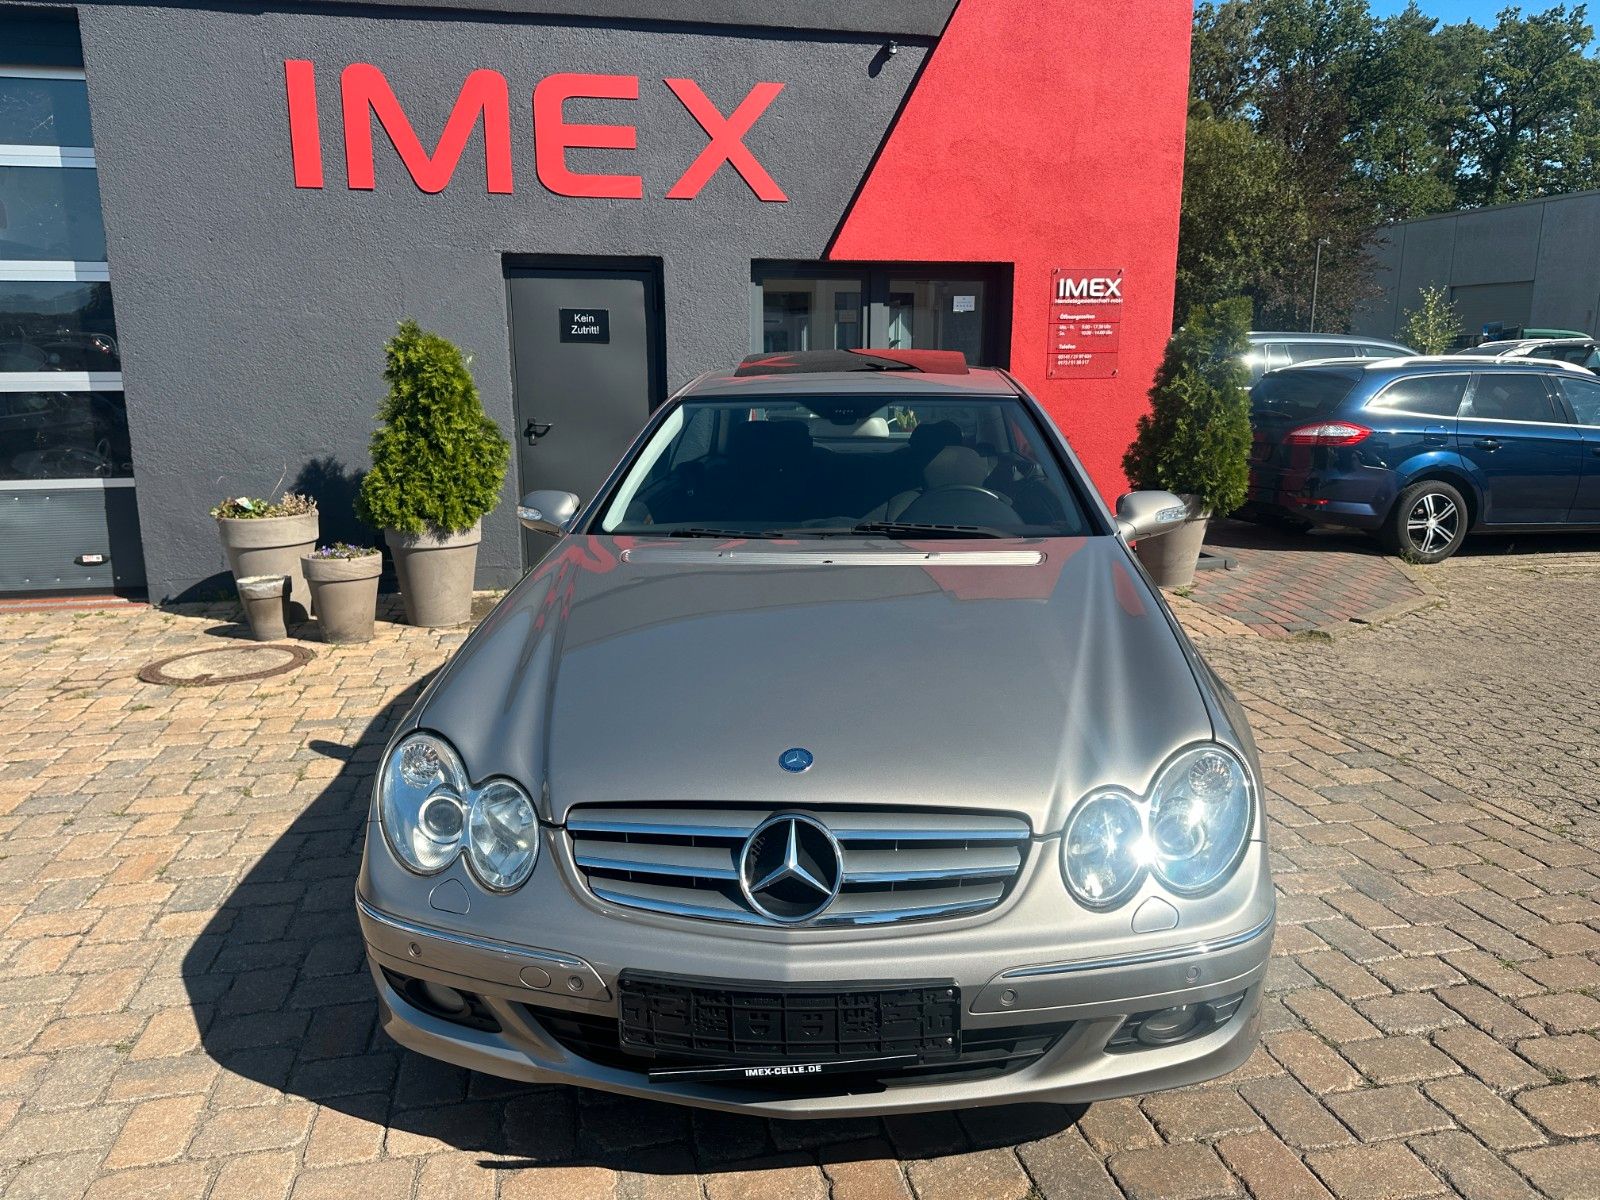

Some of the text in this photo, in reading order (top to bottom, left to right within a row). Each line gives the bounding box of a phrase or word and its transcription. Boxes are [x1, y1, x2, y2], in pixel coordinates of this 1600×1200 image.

[285, 59, 789, 202] IMEX
[1059, 278, 1122, 297] IMEX
[574, 313, 595, 323] Kein
[571, 325, 600, 335] Zutritt!
[744, 1064, 822, 1077] IMEX-CELLE.DE
